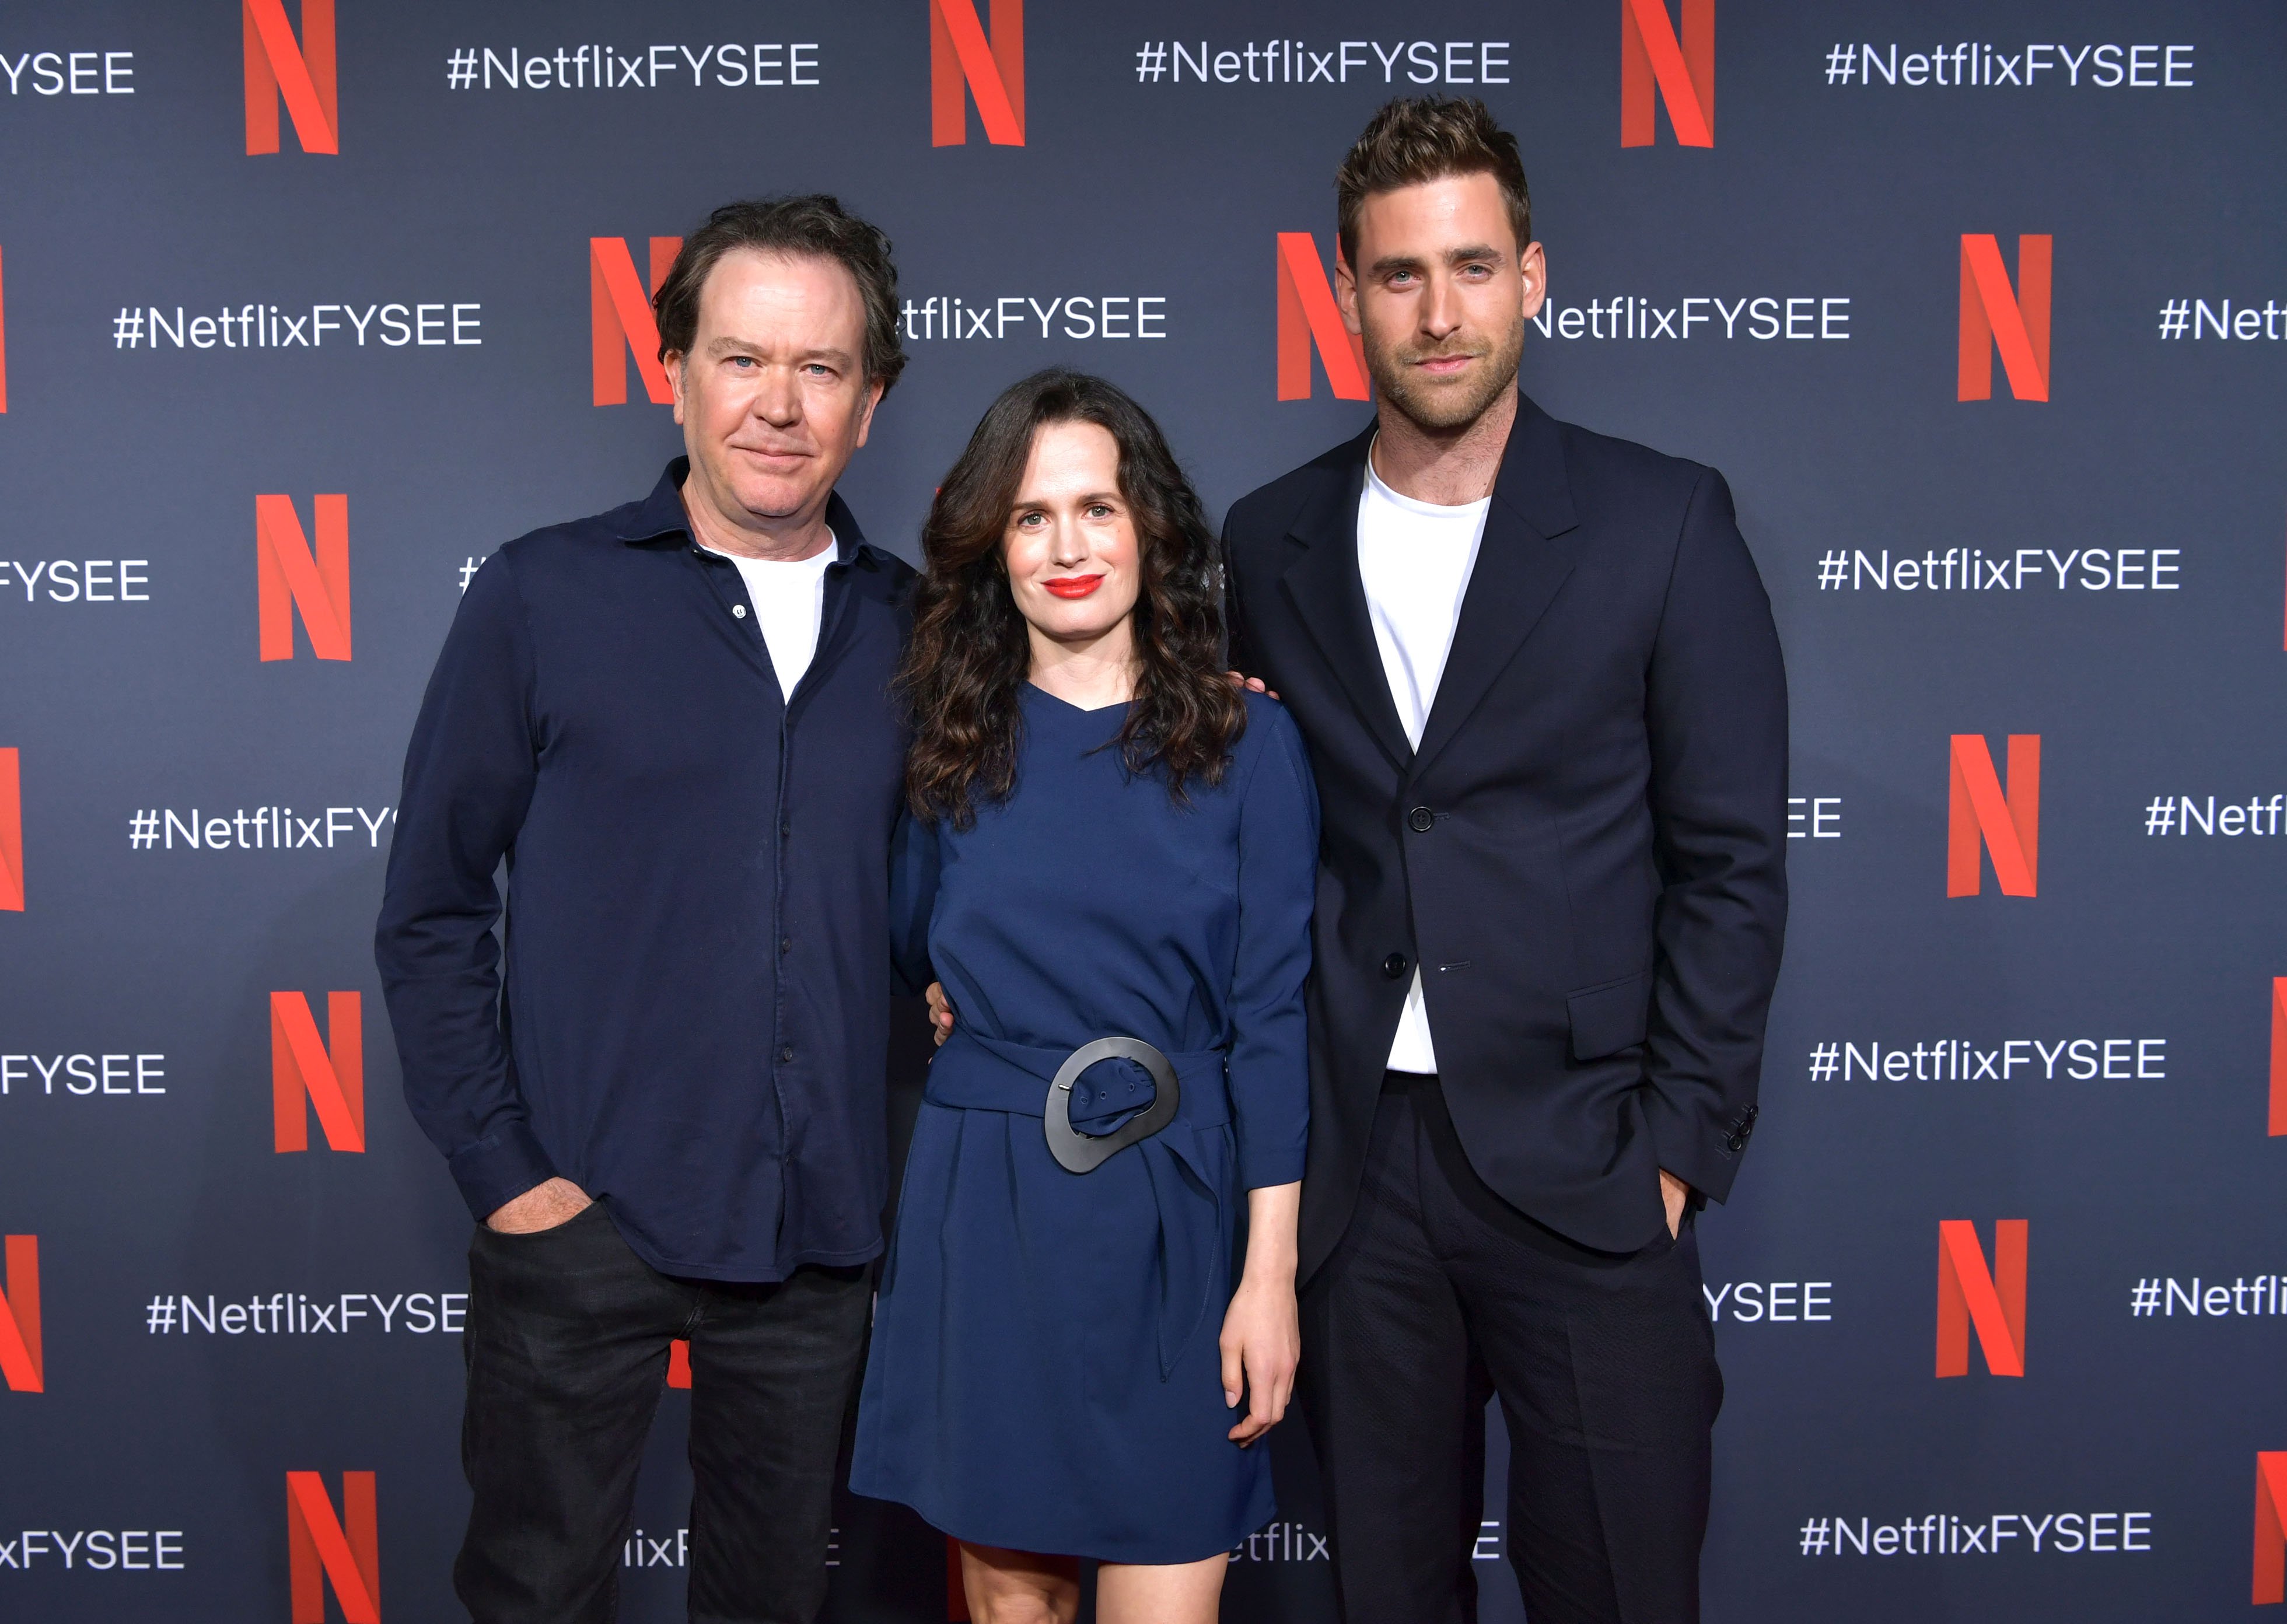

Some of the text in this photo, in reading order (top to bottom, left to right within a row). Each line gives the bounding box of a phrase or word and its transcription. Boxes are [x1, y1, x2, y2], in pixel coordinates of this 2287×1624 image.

[447, 44, 820, 89] #NetflixFYSEE
[1136, 40, 1510, 83] #NetflixFYSEE
[1825, 43, 2194, 87] #NetflixFYSEE
[113, 303, 482, 349] #NetflixFYSEE
[896, 296, 1166, 340] tflixFYSEE
[1959, 233, 2052, 402] N
[257, 494, 351, 662] N
[1817, 548, 2180, 590] #NetflixFYSEE
[129, 806, 398, 849] #NetflixFY
[1947, 734, 2040, 898] N
[271, 991, 365, 1153] N
[1809, 1039, 2166, 1082] #NetflixFYSEE
[146, 1293, 468, 1334] #NetflixFYSE
[1936, 1220, 2028, 1378] N
[1800, 1513, 2151, 1555] #NetflixFYSEE
